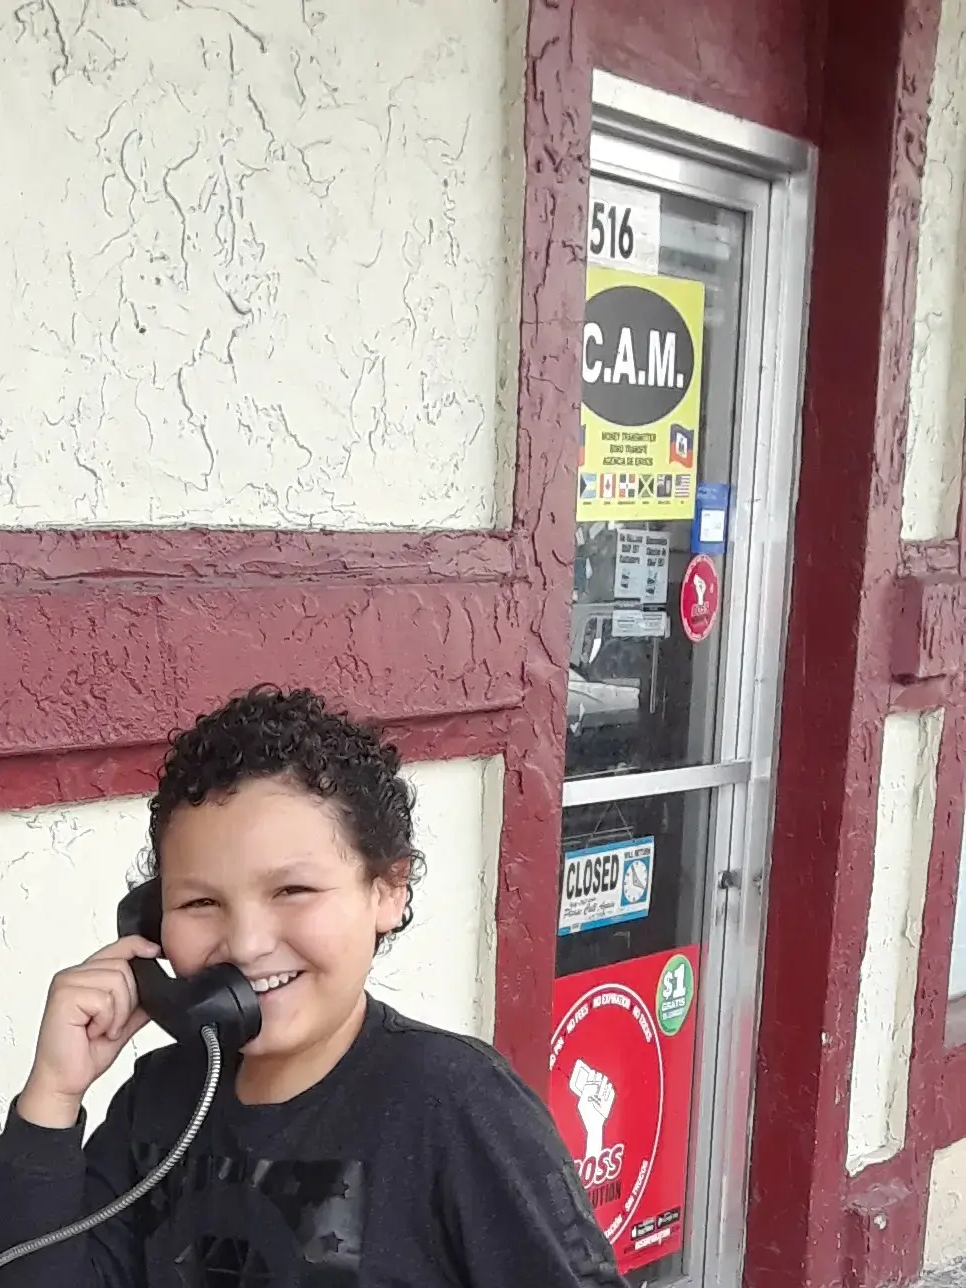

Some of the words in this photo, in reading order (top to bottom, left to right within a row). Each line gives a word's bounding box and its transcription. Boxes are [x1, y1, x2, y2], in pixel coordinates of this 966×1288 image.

[590, 201, 634, 260] 516
[582, 321, 684, 388] C.A.M.
[566, 854, 620, 900] CLOSED
[662, 963, 686, 1000] $1
